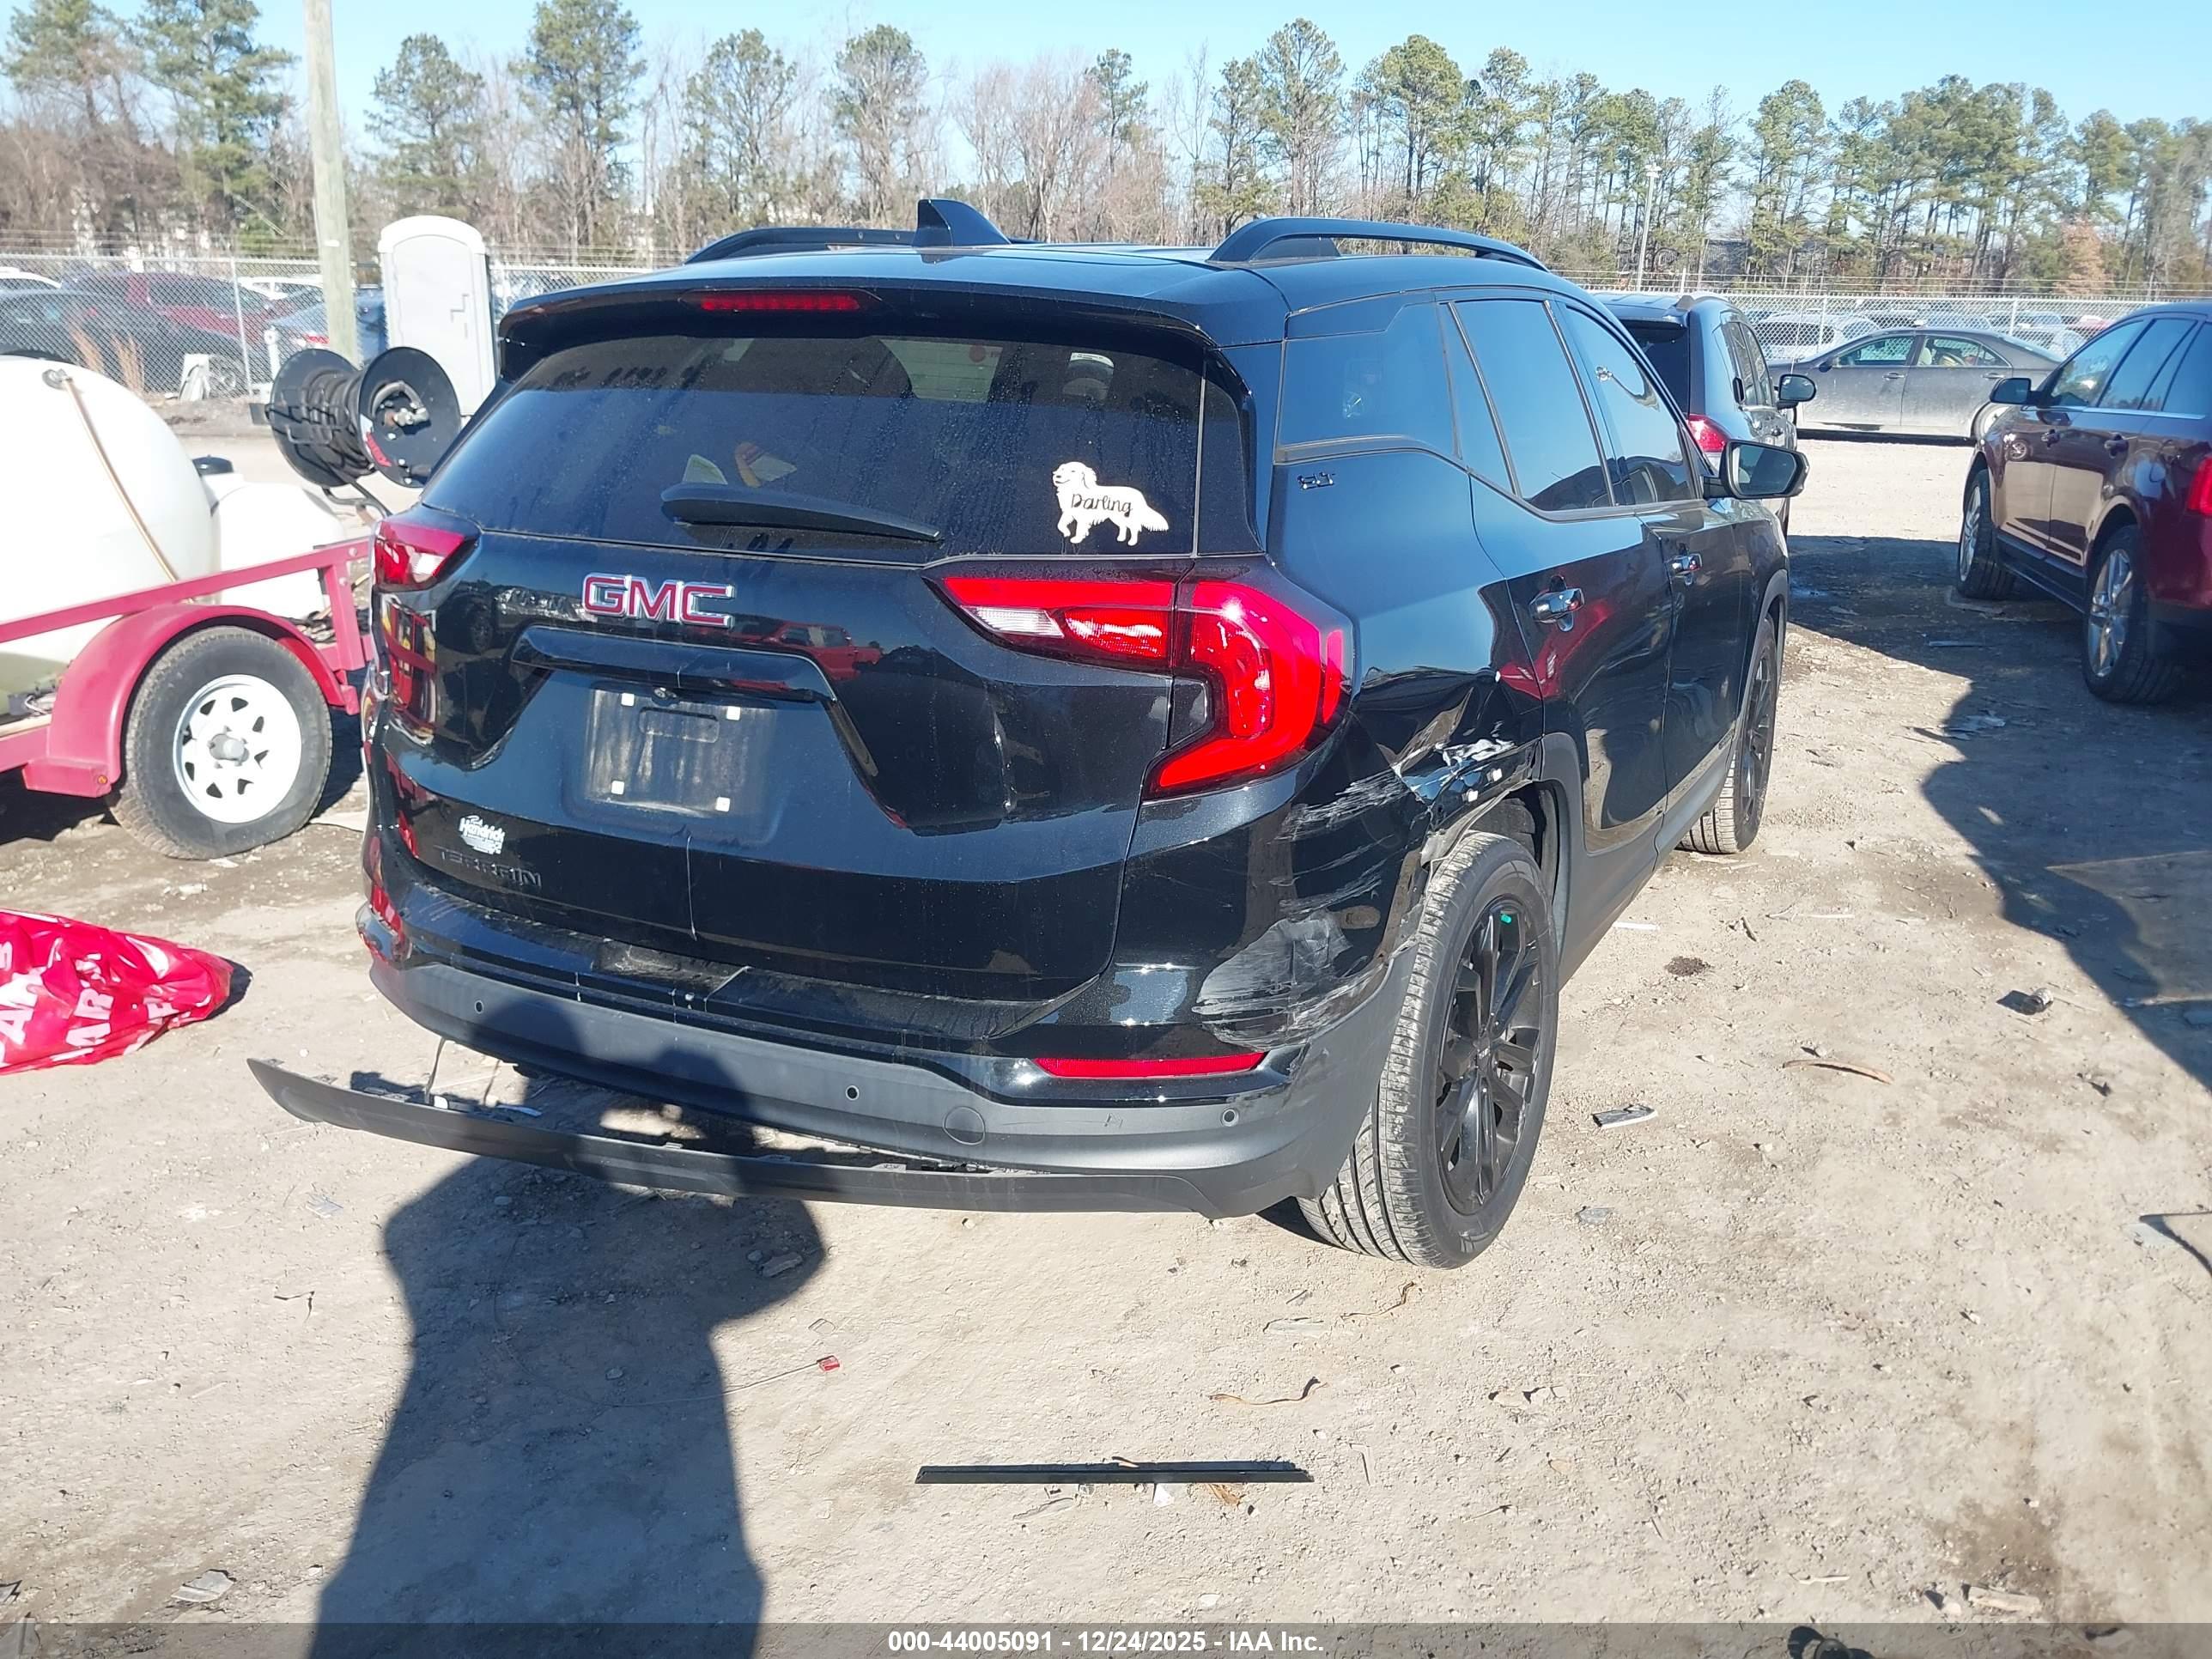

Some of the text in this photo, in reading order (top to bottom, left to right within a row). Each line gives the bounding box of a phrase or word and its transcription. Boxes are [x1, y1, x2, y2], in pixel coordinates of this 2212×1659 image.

[1071, 493, 1133, 518] Darling
[582, 573, 737, 628] GMC
[433, 844, 543, 889] TERRAIN
